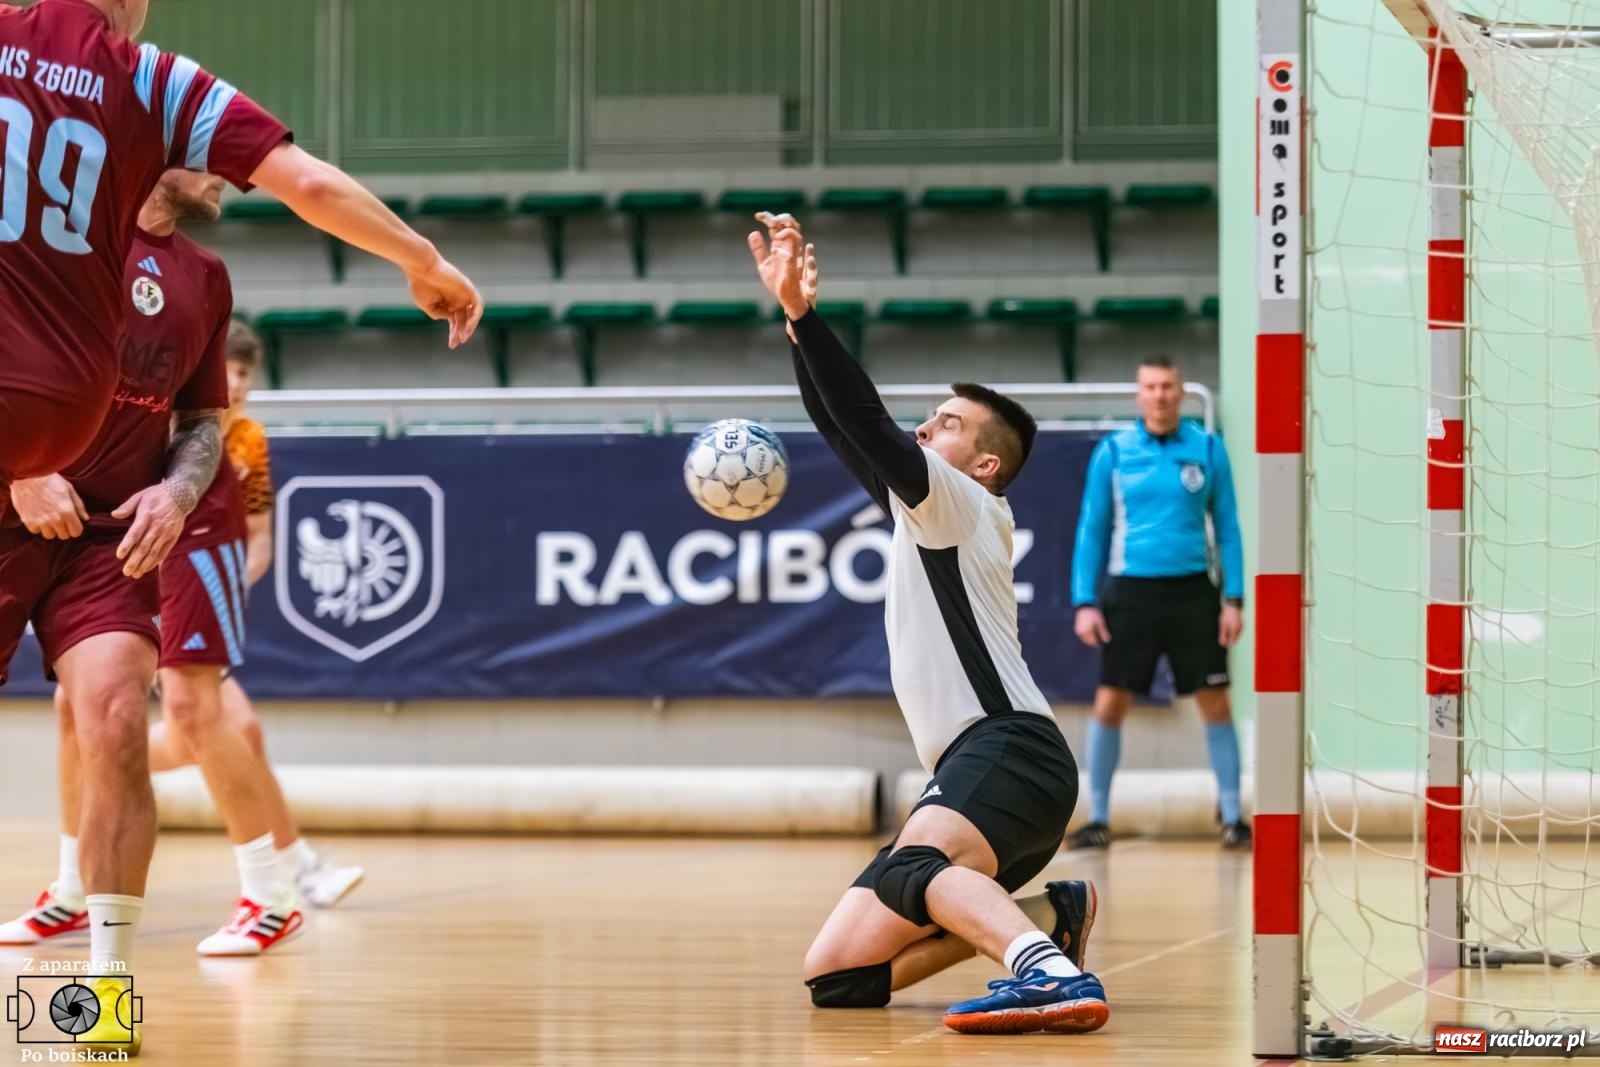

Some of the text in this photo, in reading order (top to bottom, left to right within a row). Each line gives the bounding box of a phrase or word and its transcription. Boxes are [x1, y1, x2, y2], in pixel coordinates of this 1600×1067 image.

[33, 58, 105, 106] ZGODA
[1271, 182, 1288, 294] sport
[535, 502, 1034, 605] RACIBÓ
